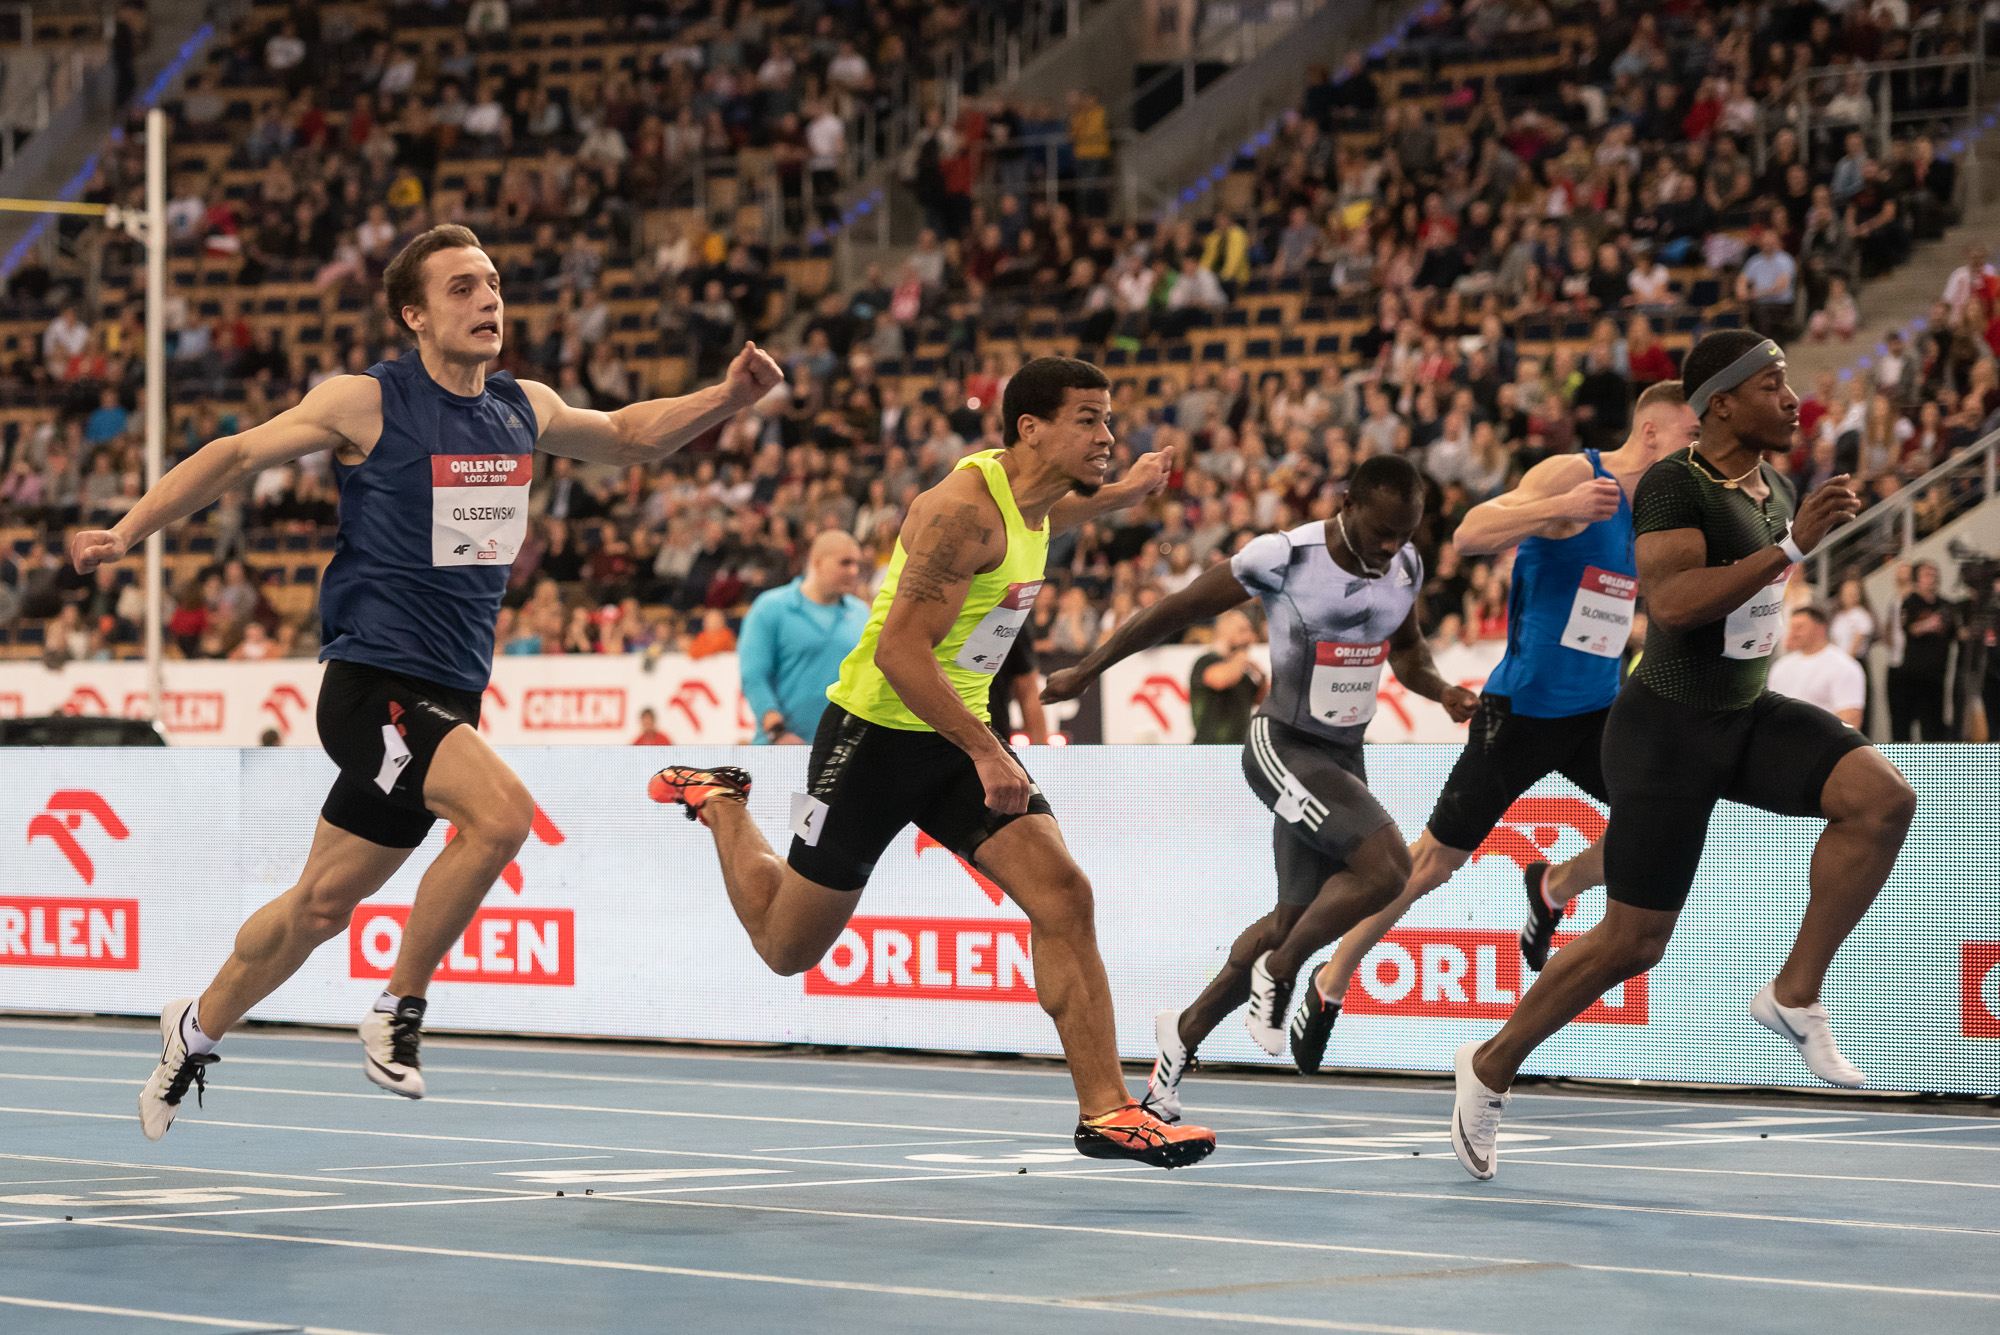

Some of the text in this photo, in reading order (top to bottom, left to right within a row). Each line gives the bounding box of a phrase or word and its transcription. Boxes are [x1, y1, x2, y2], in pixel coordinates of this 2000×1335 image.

[451, 460, 518, 473] ORLEN CUP
[489, 475, 508, 483] 2019
[452, 507, 516, 521] OLSZEWSKI
[1334, 647, 1368, 657] ORLEN
[361, 915, 559, 975] OLEN
[1360, 942, 1625, 1008] ORL
